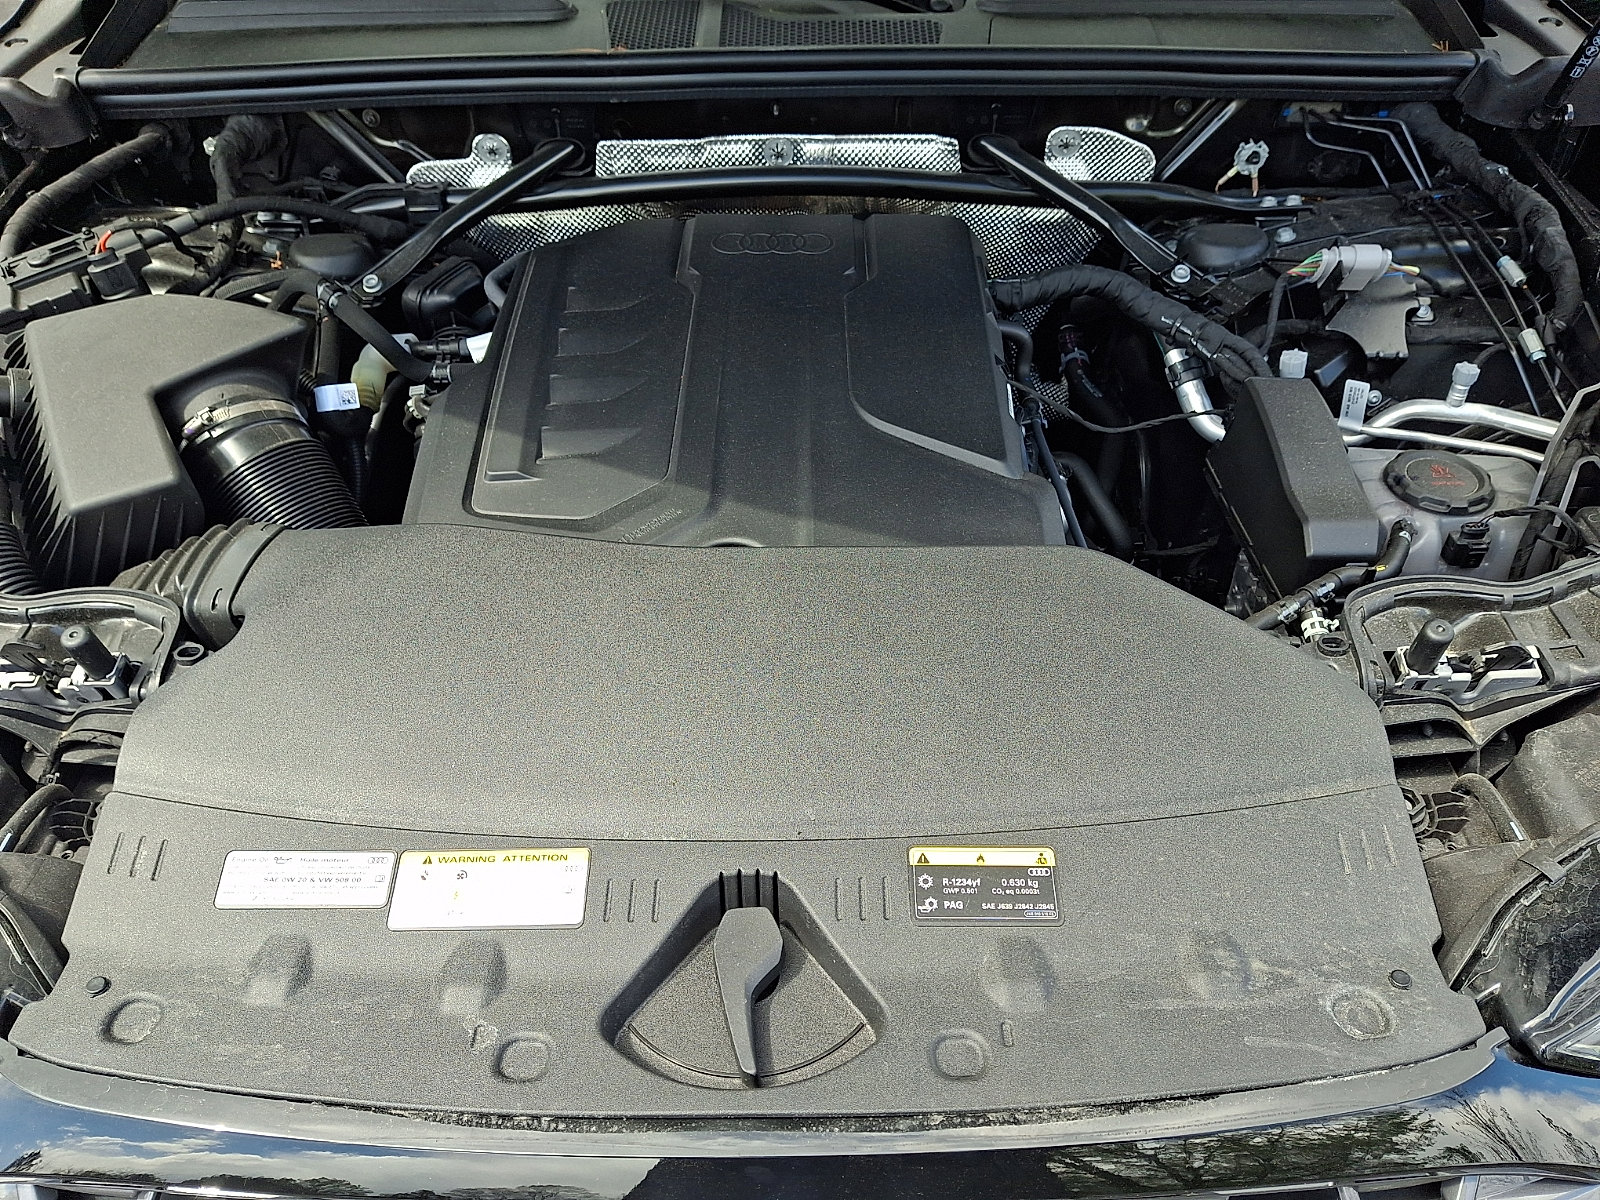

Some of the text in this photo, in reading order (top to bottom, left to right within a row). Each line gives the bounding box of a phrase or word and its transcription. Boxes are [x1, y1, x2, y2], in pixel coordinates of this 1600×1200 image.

[438, 854, 568, 864] WARNING ATTENTION
[942, 878, 981, 888] R-1234yf
[1001, 878, 1039, 888] 0.630 kg
[943, 901, 964, 910] PAG
